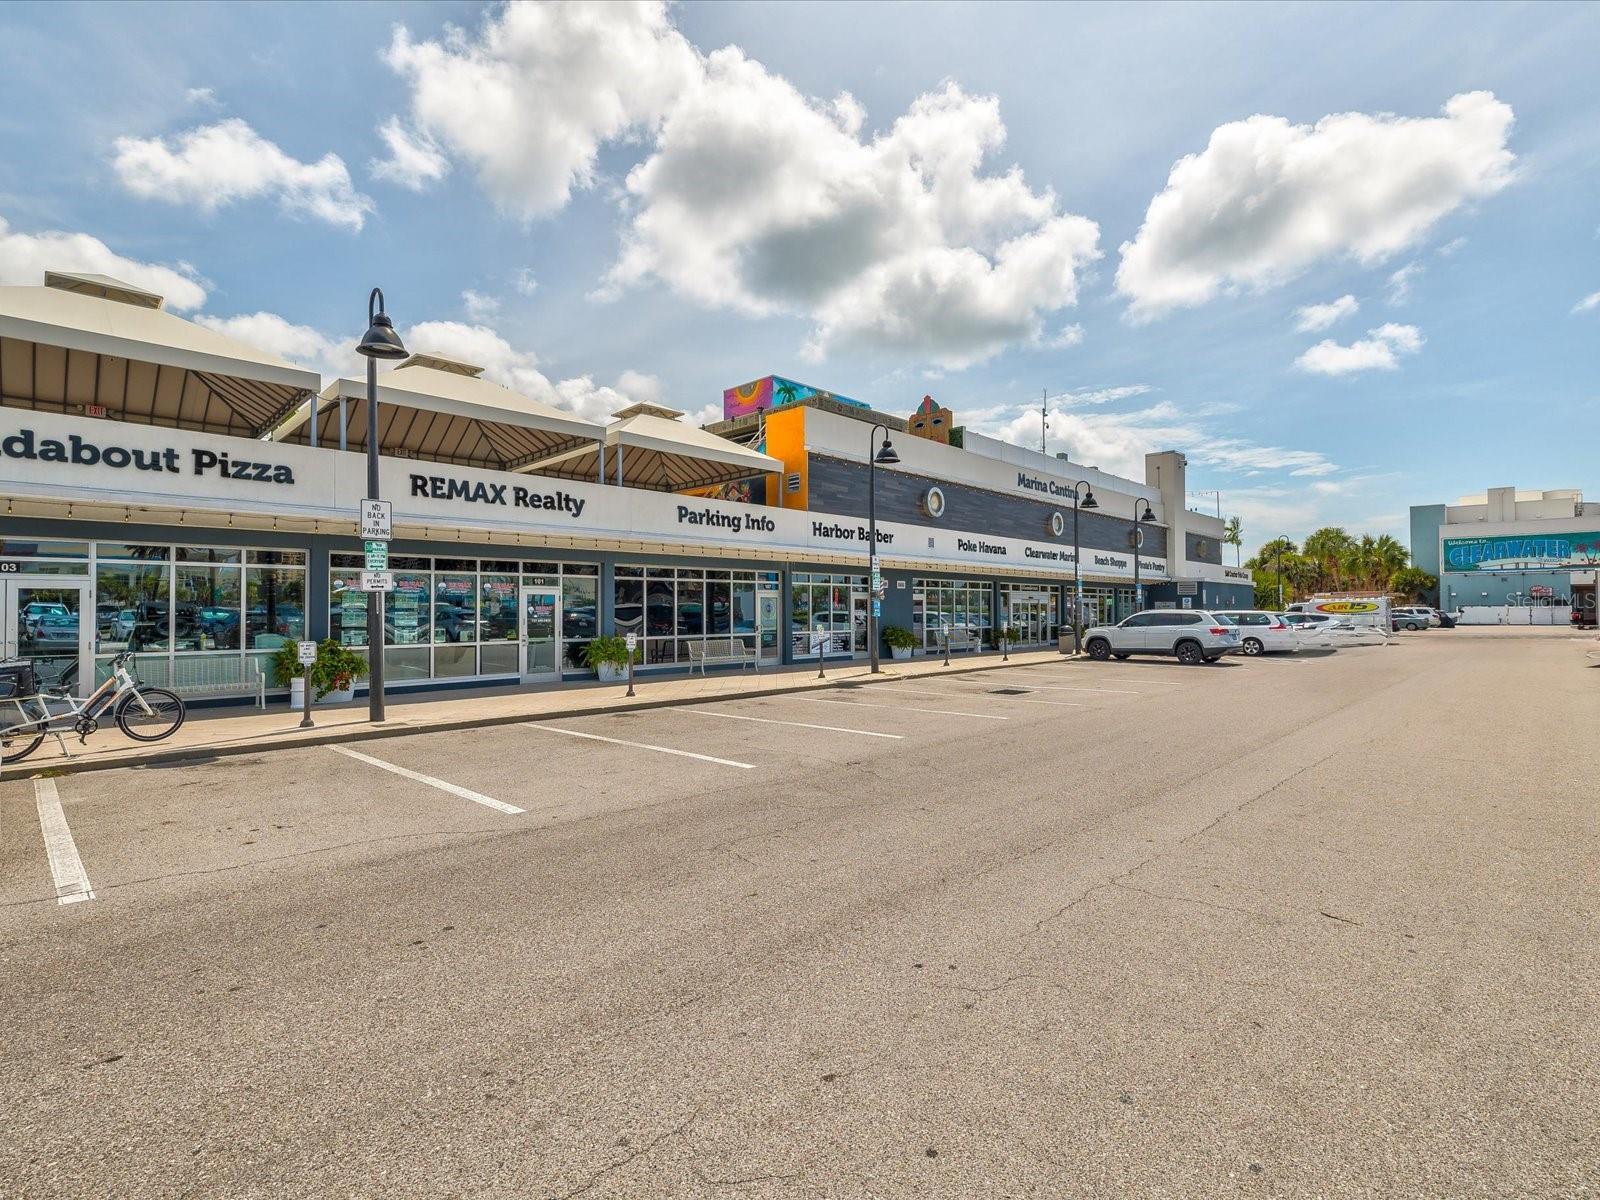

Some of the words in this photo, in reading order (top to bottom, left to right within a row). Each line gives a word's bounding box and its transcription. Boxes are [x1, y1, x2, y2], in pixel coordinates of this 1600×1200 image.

[0, 430, 179, 473] dabout
[192, 448, 294, 484] Pizza
[1017, 472, 1048, 493] Marina
[410, 474, 507, 505] REMAX
[513, 487, 585, 517] Realty
[677, 505, 742, 533] Parking
[745, 513, 776, 532] Info
[363, 528, 389, 536] PARKING
[812, 522, 856, 540] Harbor
[858, 526, 893, 543] Baber
[957, 538, 977, 553] Poke
[978, 541, 1007, 557] Havana
[1024, 546, 1059, 561] Clearwater
[1449, 539, 1571, 566] CLEARWATER
[1, 563, 17, 572] 03
[1094, 555, 1110, 566] Beach
[1110, 557, 1127, 569] Shoppe
